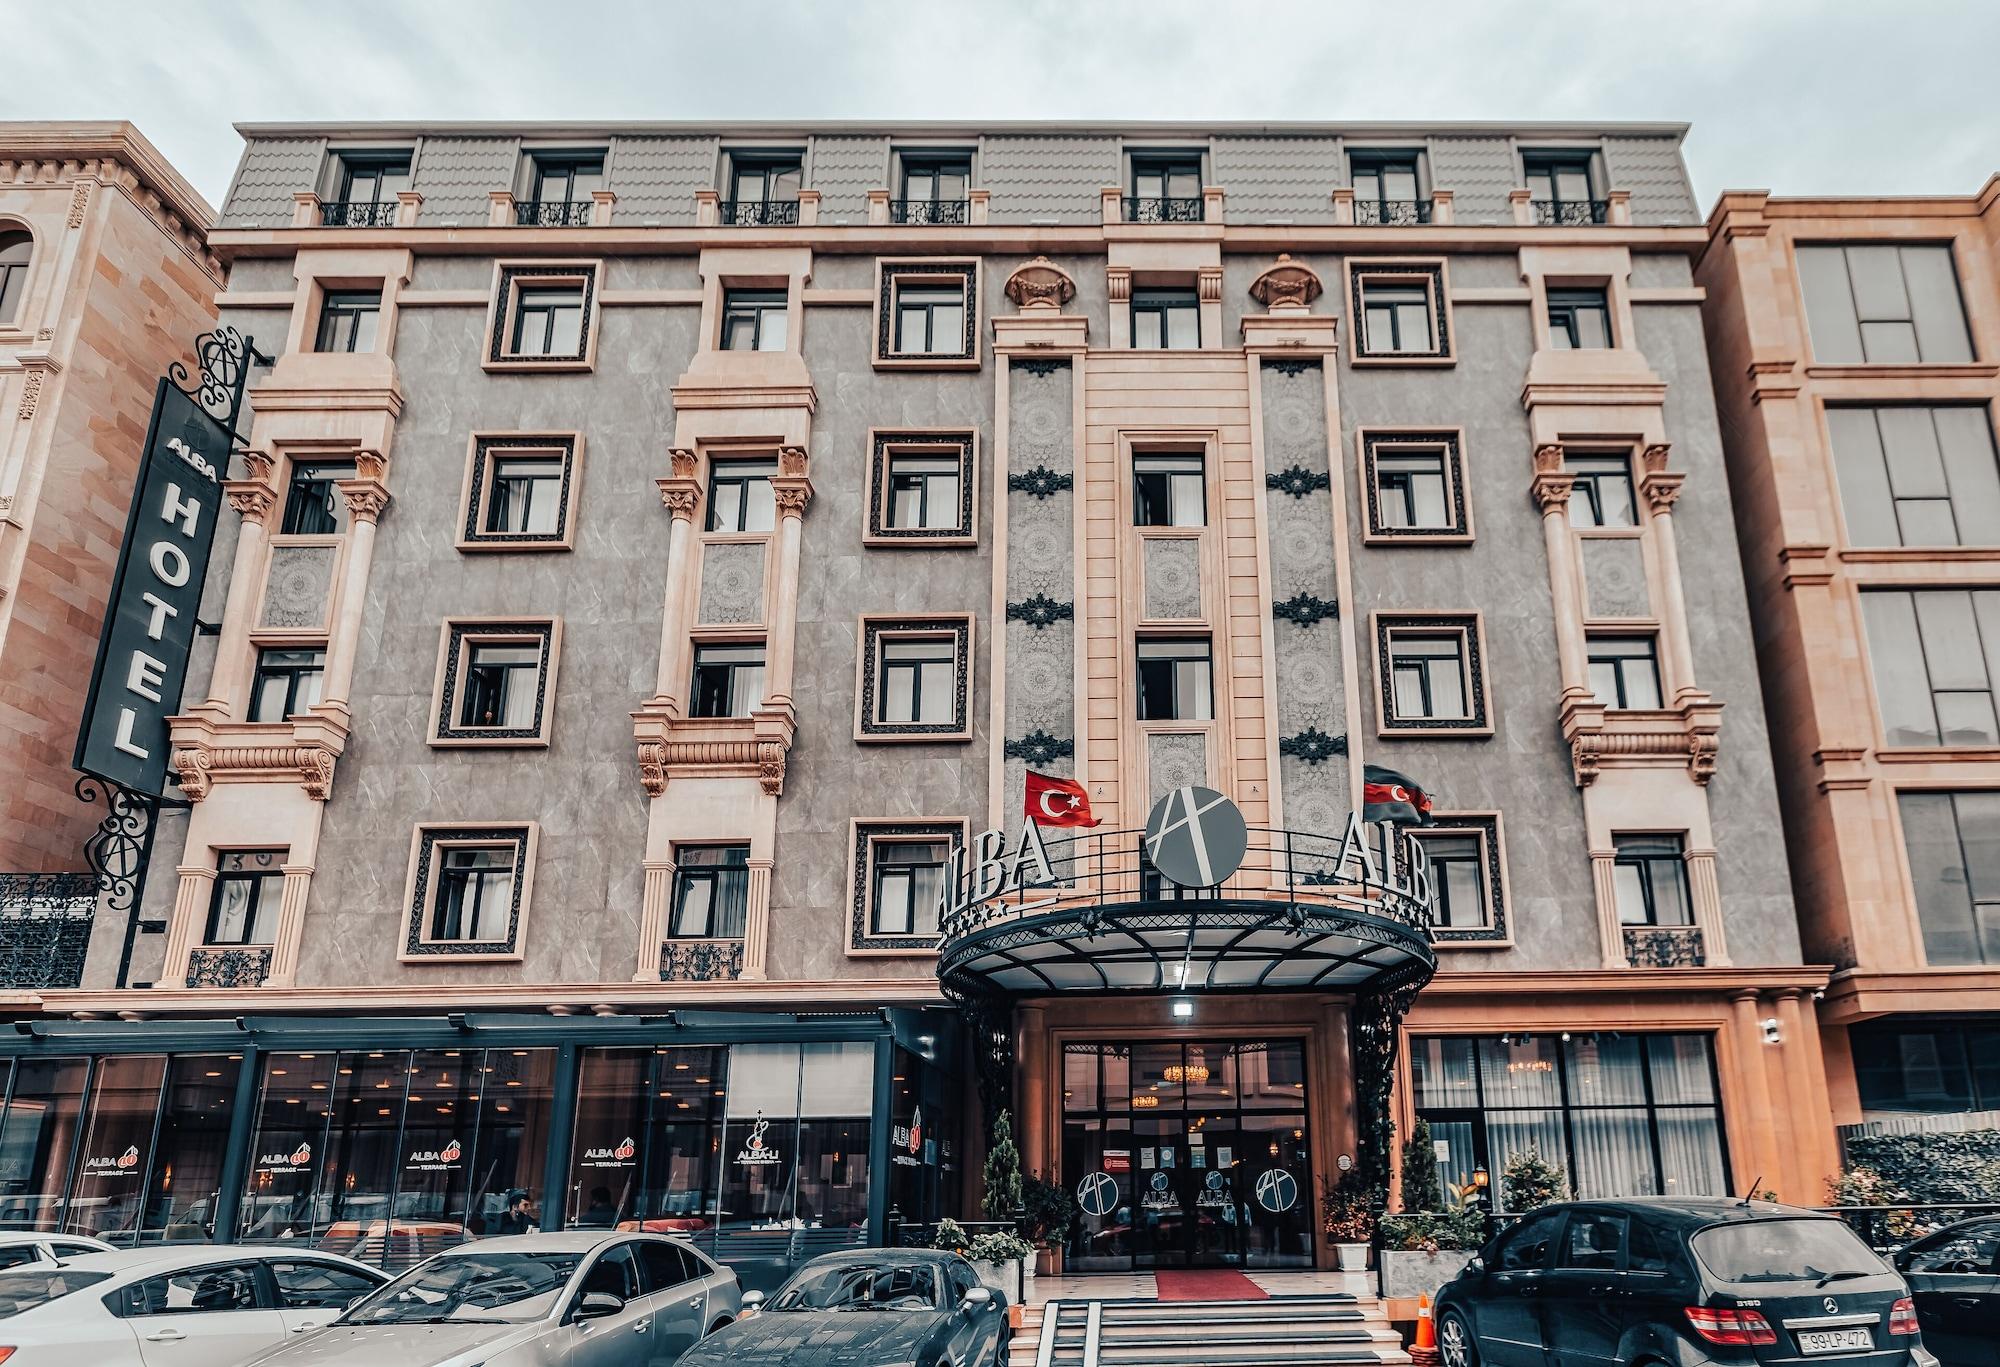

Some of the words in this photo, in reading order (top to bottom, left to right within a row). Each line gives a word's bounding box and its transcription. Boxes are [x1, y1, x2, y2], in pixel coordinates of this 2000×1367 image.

[166, 437, 217, 483] ALBA
[114, 482, 200, 759] HOTEL
[892, 1125, 909, 1147] ALBA
[260, 1154, 289, 1164] ALBA
[410, 1152, 439, 1161] ALBA
[585, 1148, 613, 1158] ALBA
[87, 1157, 116, 1167] ALBA
[1141, 1190, 1179, 1205] ALBA
[1196, 1189, 1234, 1203] ALBA
[1810, 1330, 1869, 1350] 99-LP-472
